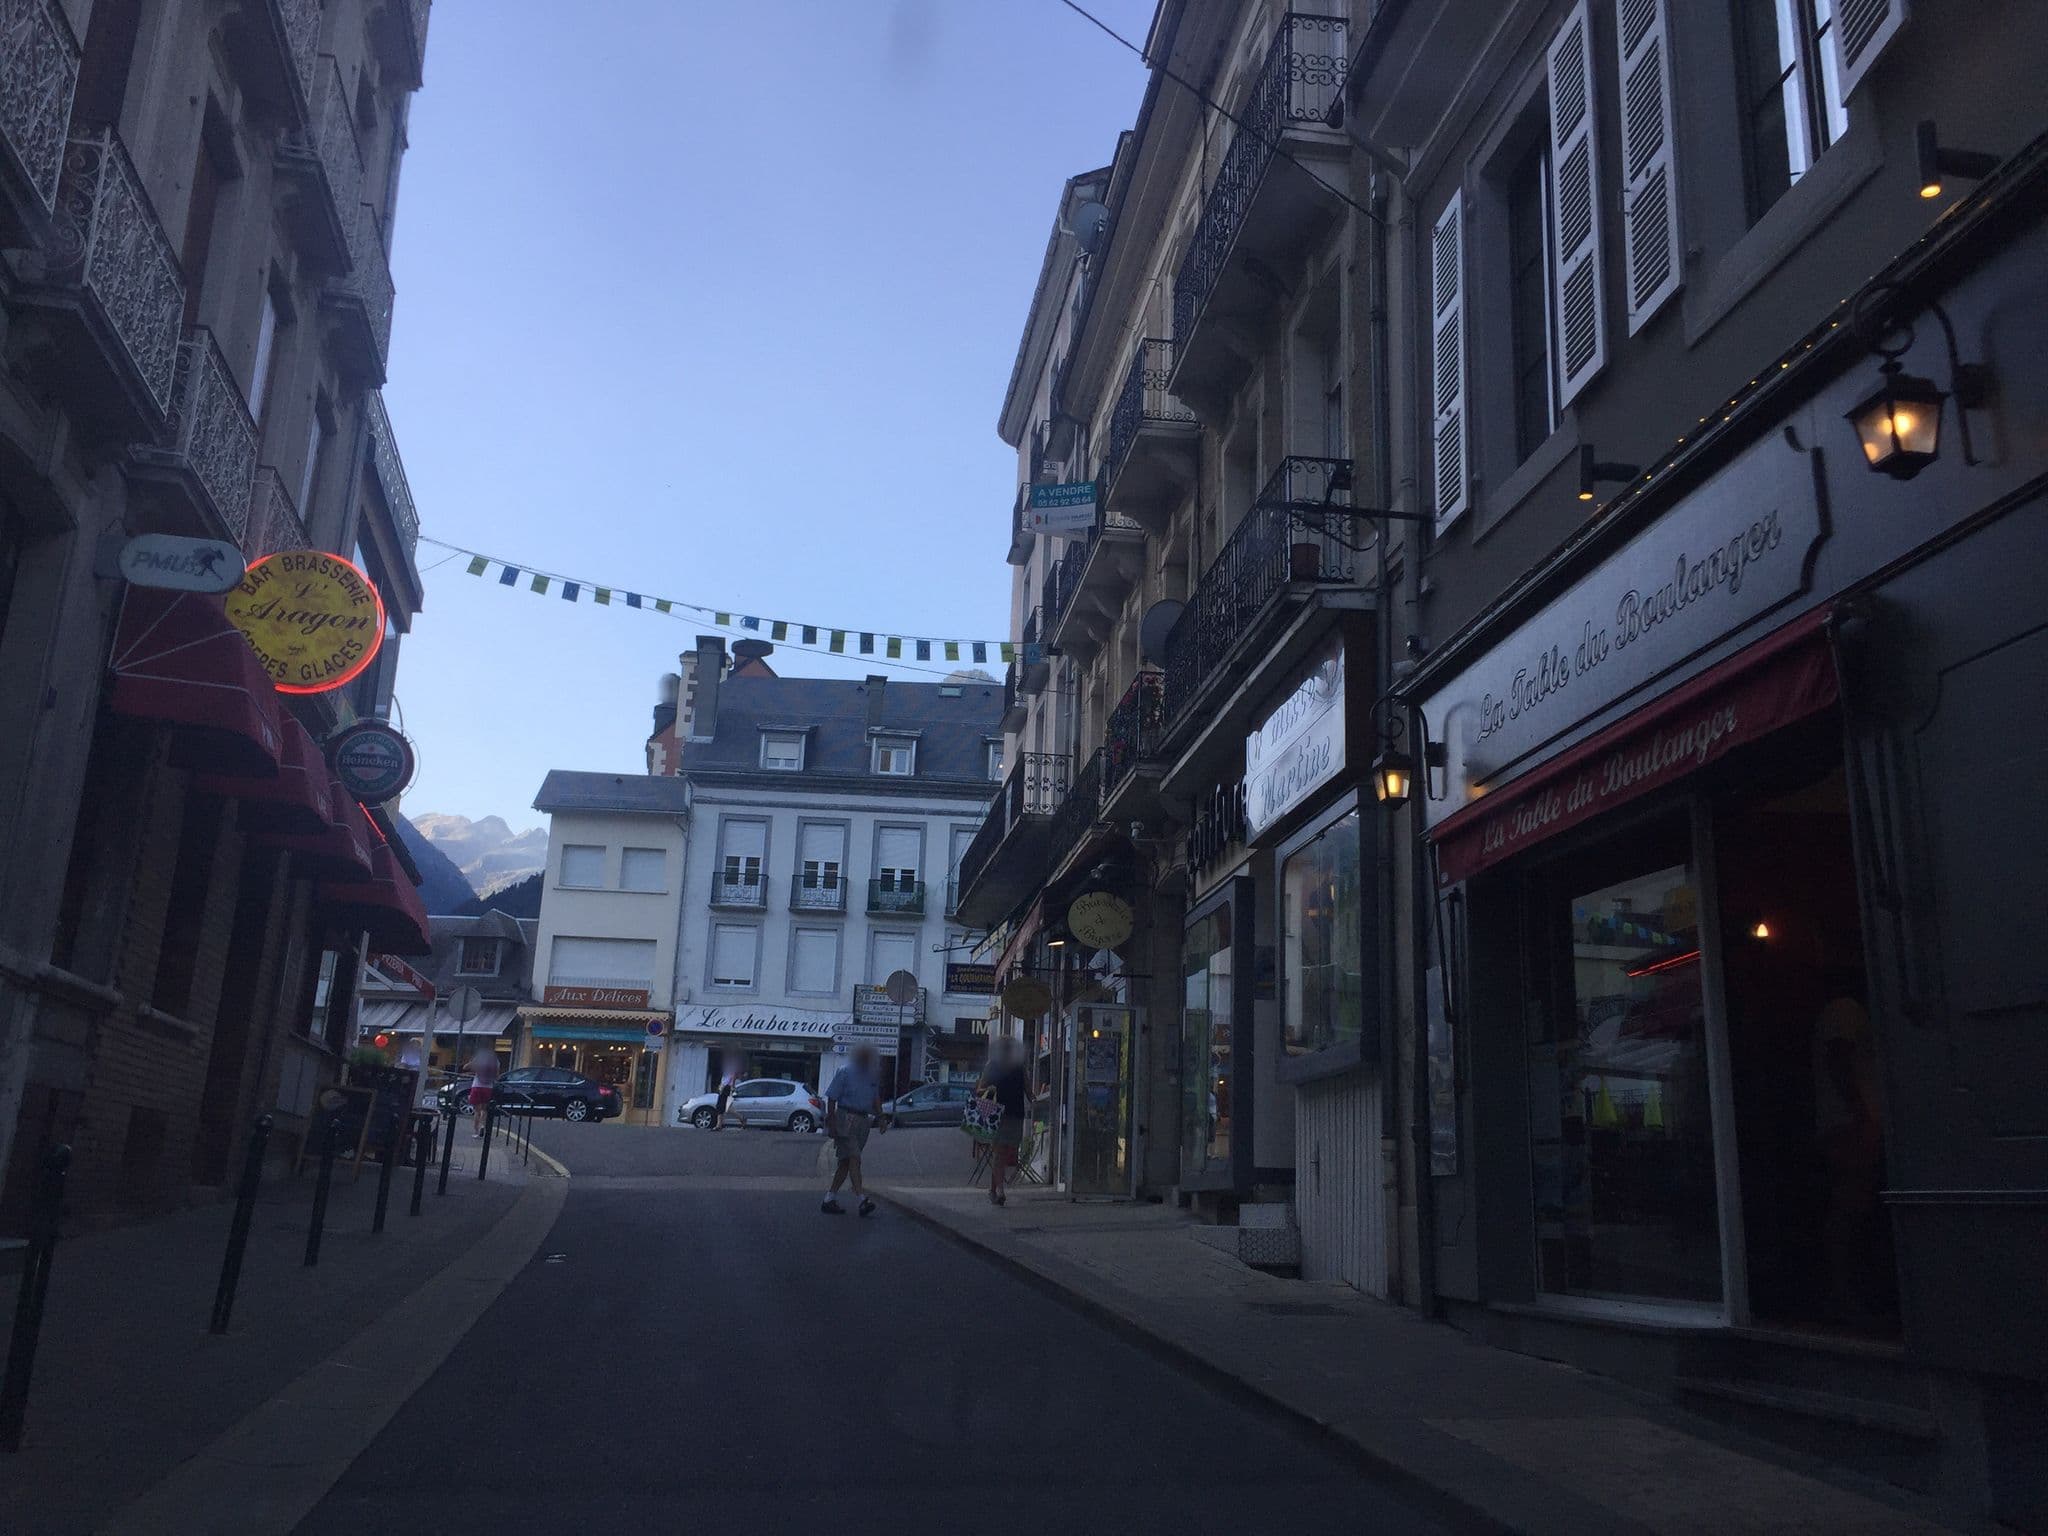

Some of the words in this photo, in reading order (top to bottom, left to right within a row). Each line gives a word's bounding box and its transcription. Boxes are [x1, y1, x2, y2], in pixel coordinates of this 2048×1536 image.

[1038, 488, 1046, 497] A
[1047, 486, 1092, 496] VENDRE
[240, 564, 274, 596] BAR
[281, 554, 370, 607] BRASSERIE
[233, 596, 370, 636] Aragon
[1477, 693, 1506, 744] La
[1509, 645, 1570, 720] Table
[1575, 620, 1610, 677] du
[1614, 509, 1783, 650] Boulanger
[300, 638, 364, 681] GLACES
[341, 753, 399, 769] Heineken
[1259, 735, 1331, 827] Martine
[1481, 817, 1505, 856] La
[1509, 791, 1561, 839] Table
[1567, 774, 1595, 814] du
[1600, 704, 1739, 798] Boulanger
[548, 987, 588, 1003] Aux
[696, 1007, 728, 1028] Le
[732, 1013, 831, 1034] chabarrou
